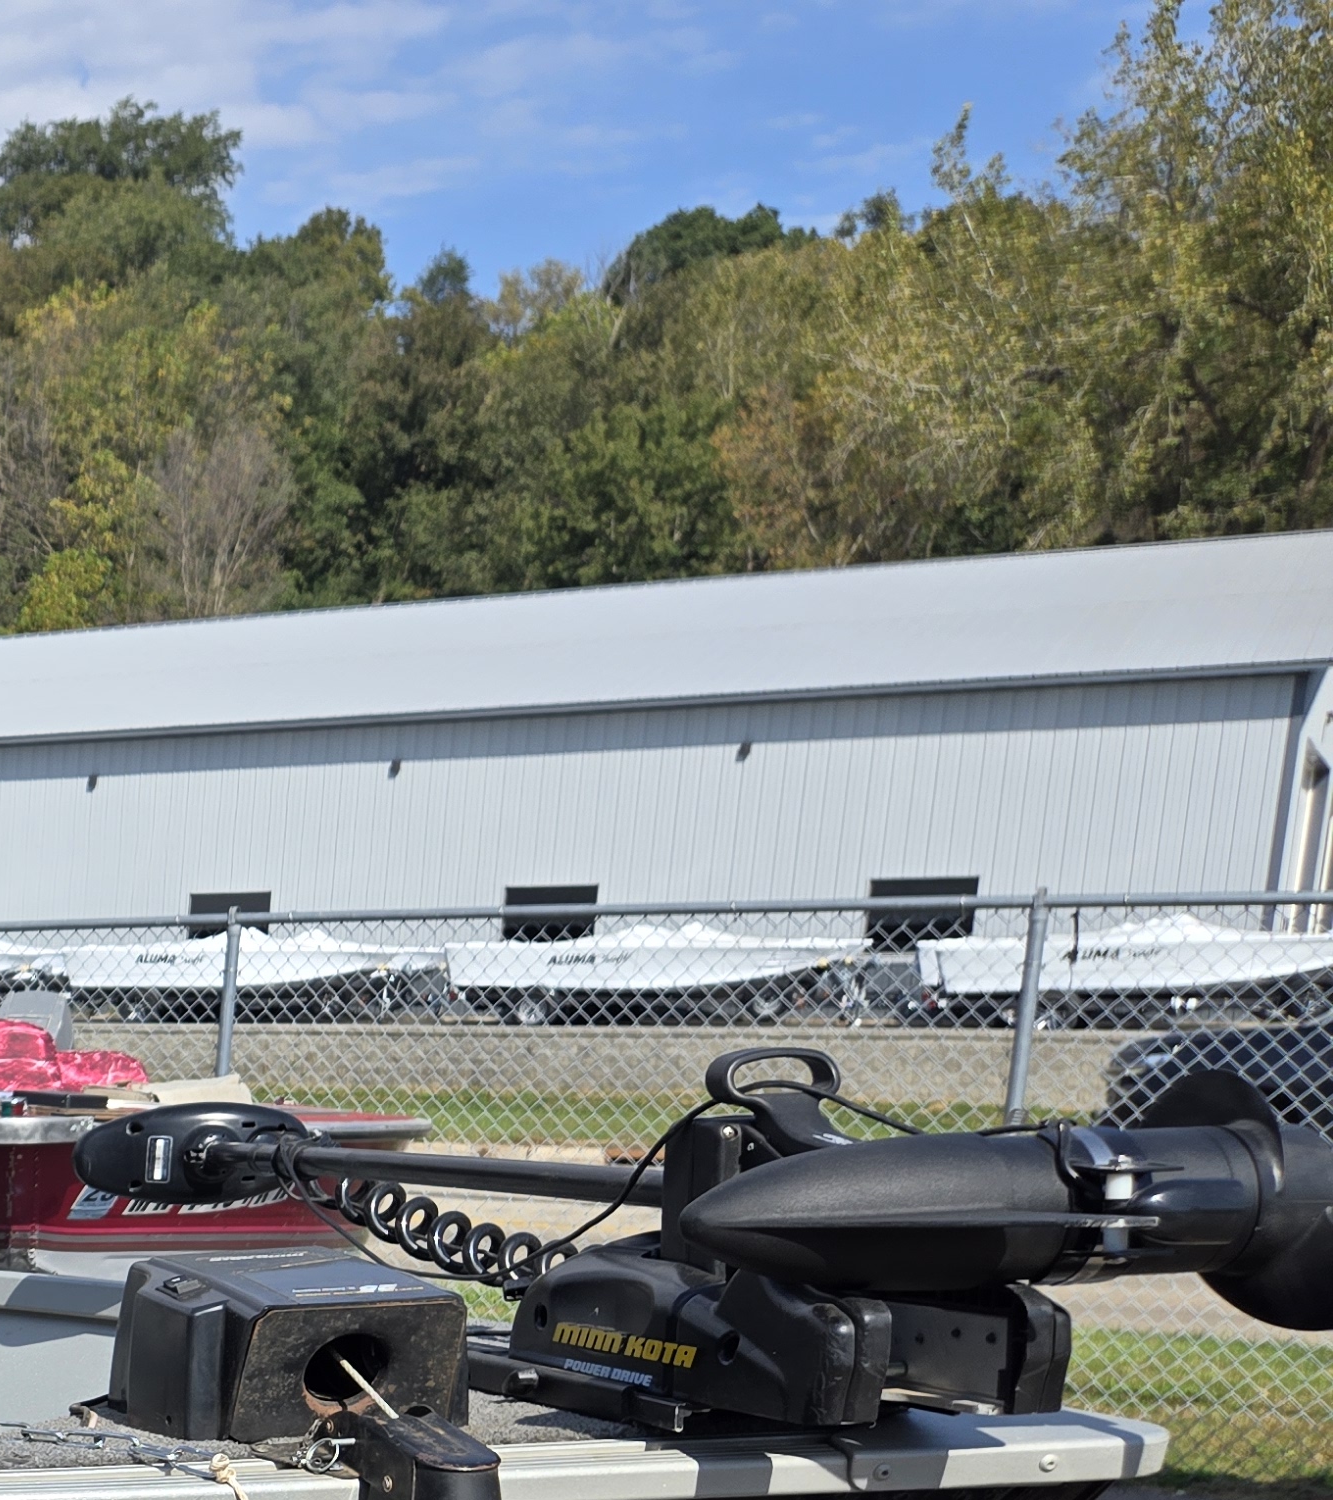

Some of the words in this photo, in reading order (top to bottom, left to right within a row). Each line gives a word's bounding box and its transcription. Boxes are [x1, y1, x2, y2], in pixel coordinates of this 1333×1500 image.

[552, 1321, 623, 1354] MINN
[624, 1335, 697, 1368] KOTA
[564, 1358, 611, 1379] POWER
[611, 1367, 653, 1387] DRIVE
